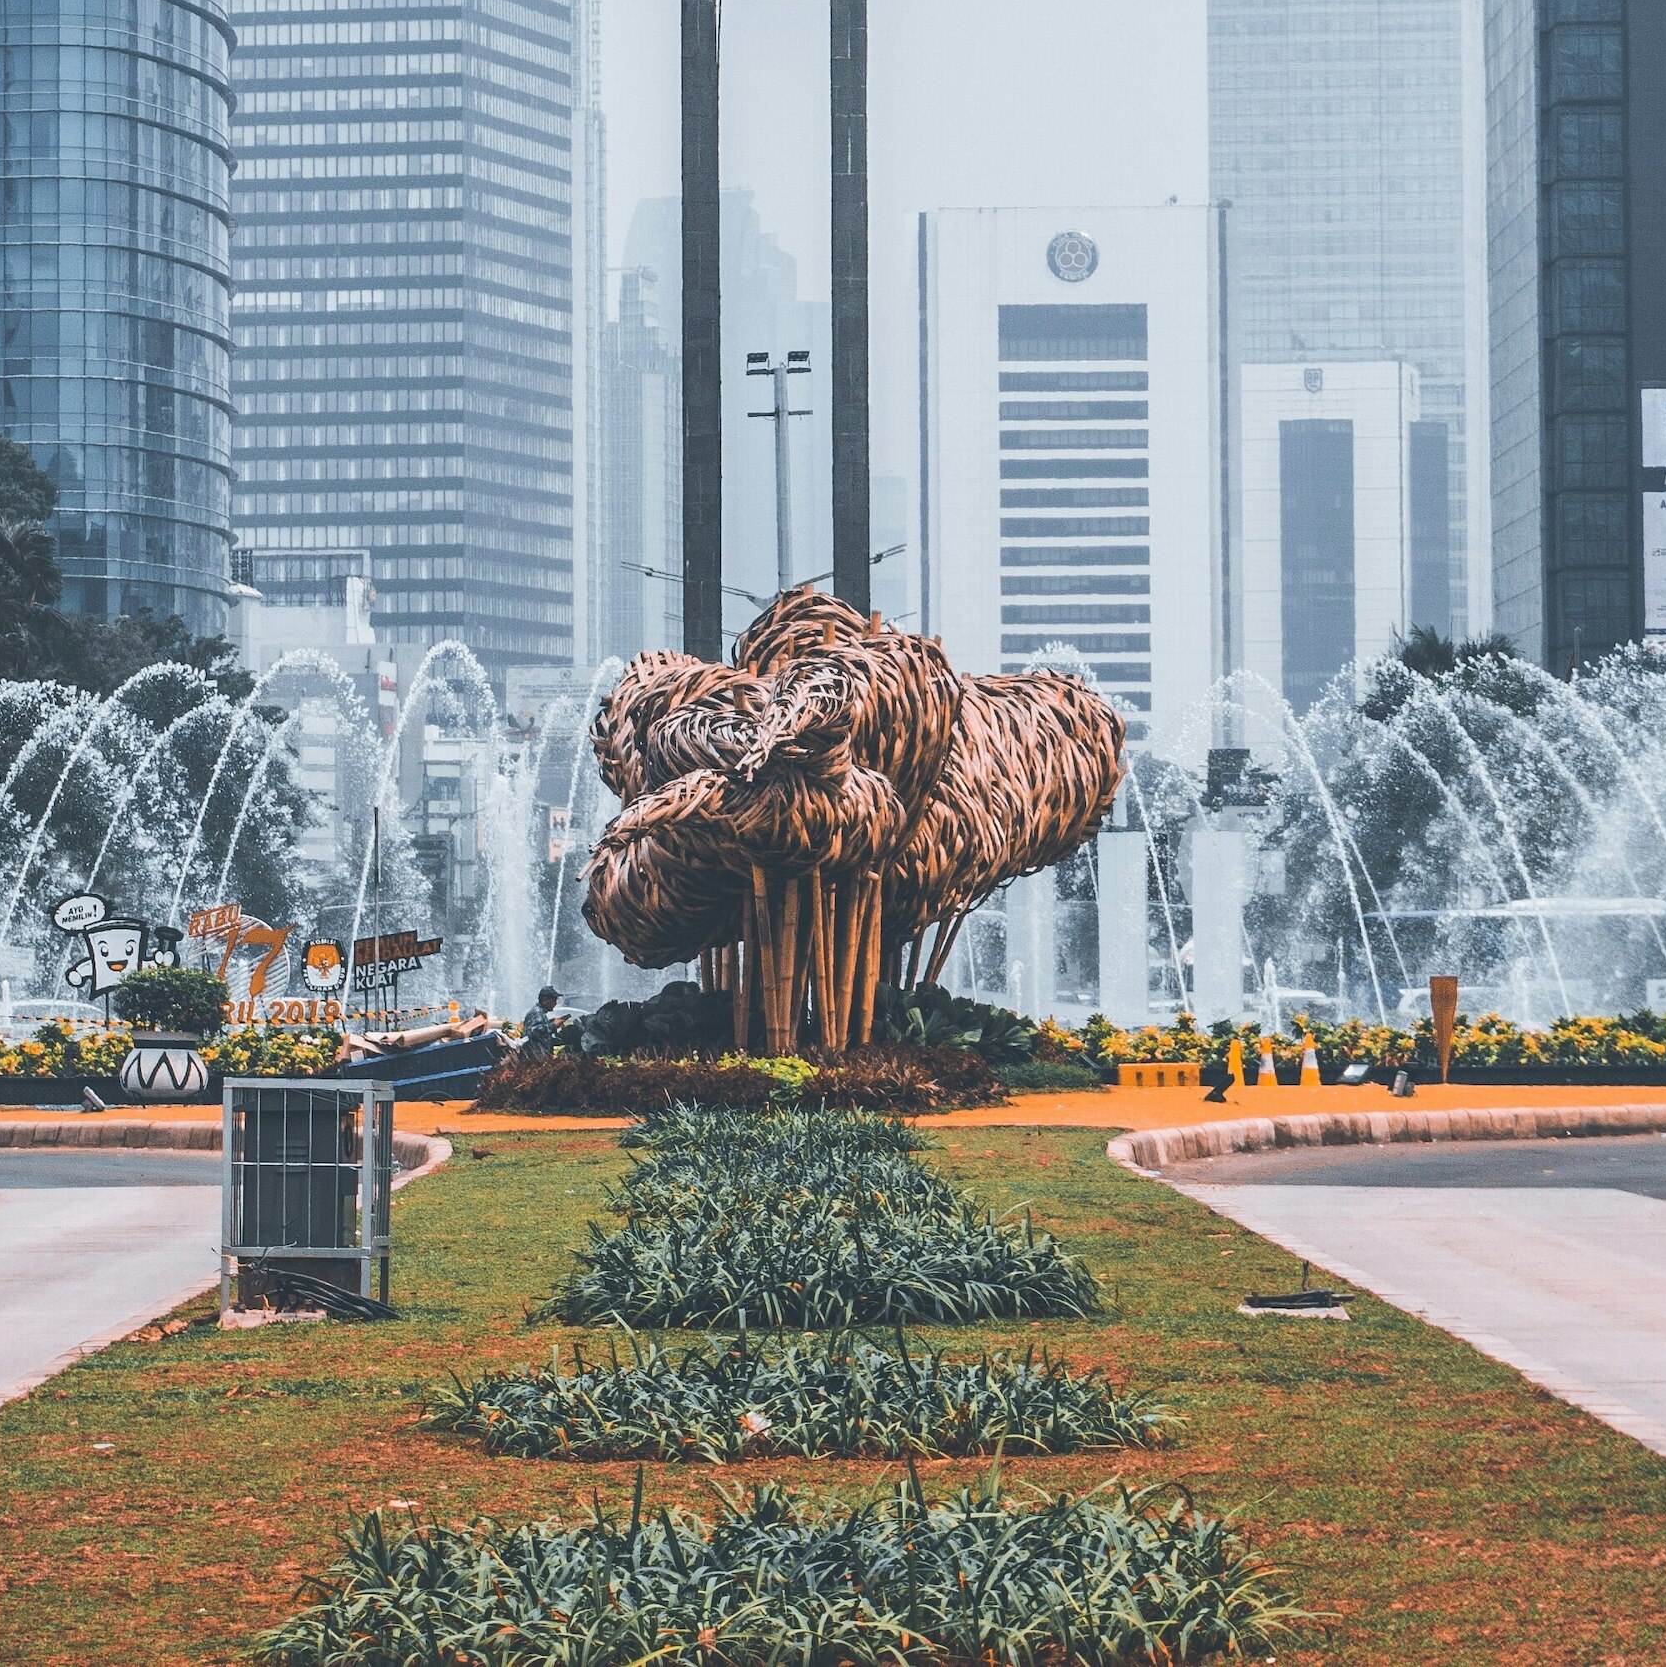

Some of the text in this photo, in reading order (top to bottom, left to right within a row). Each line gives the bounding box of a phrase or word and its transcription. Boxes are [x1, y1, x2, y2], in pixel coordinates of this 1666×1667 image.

[69, 905, 84, 915] AYO
[189, 907, 241, 935] RABU
[355, 957, 417, 977] NEGARA
[356, 972, 394, 990] KUAT
[220, 1000, 343, 1025] RIL 2019
